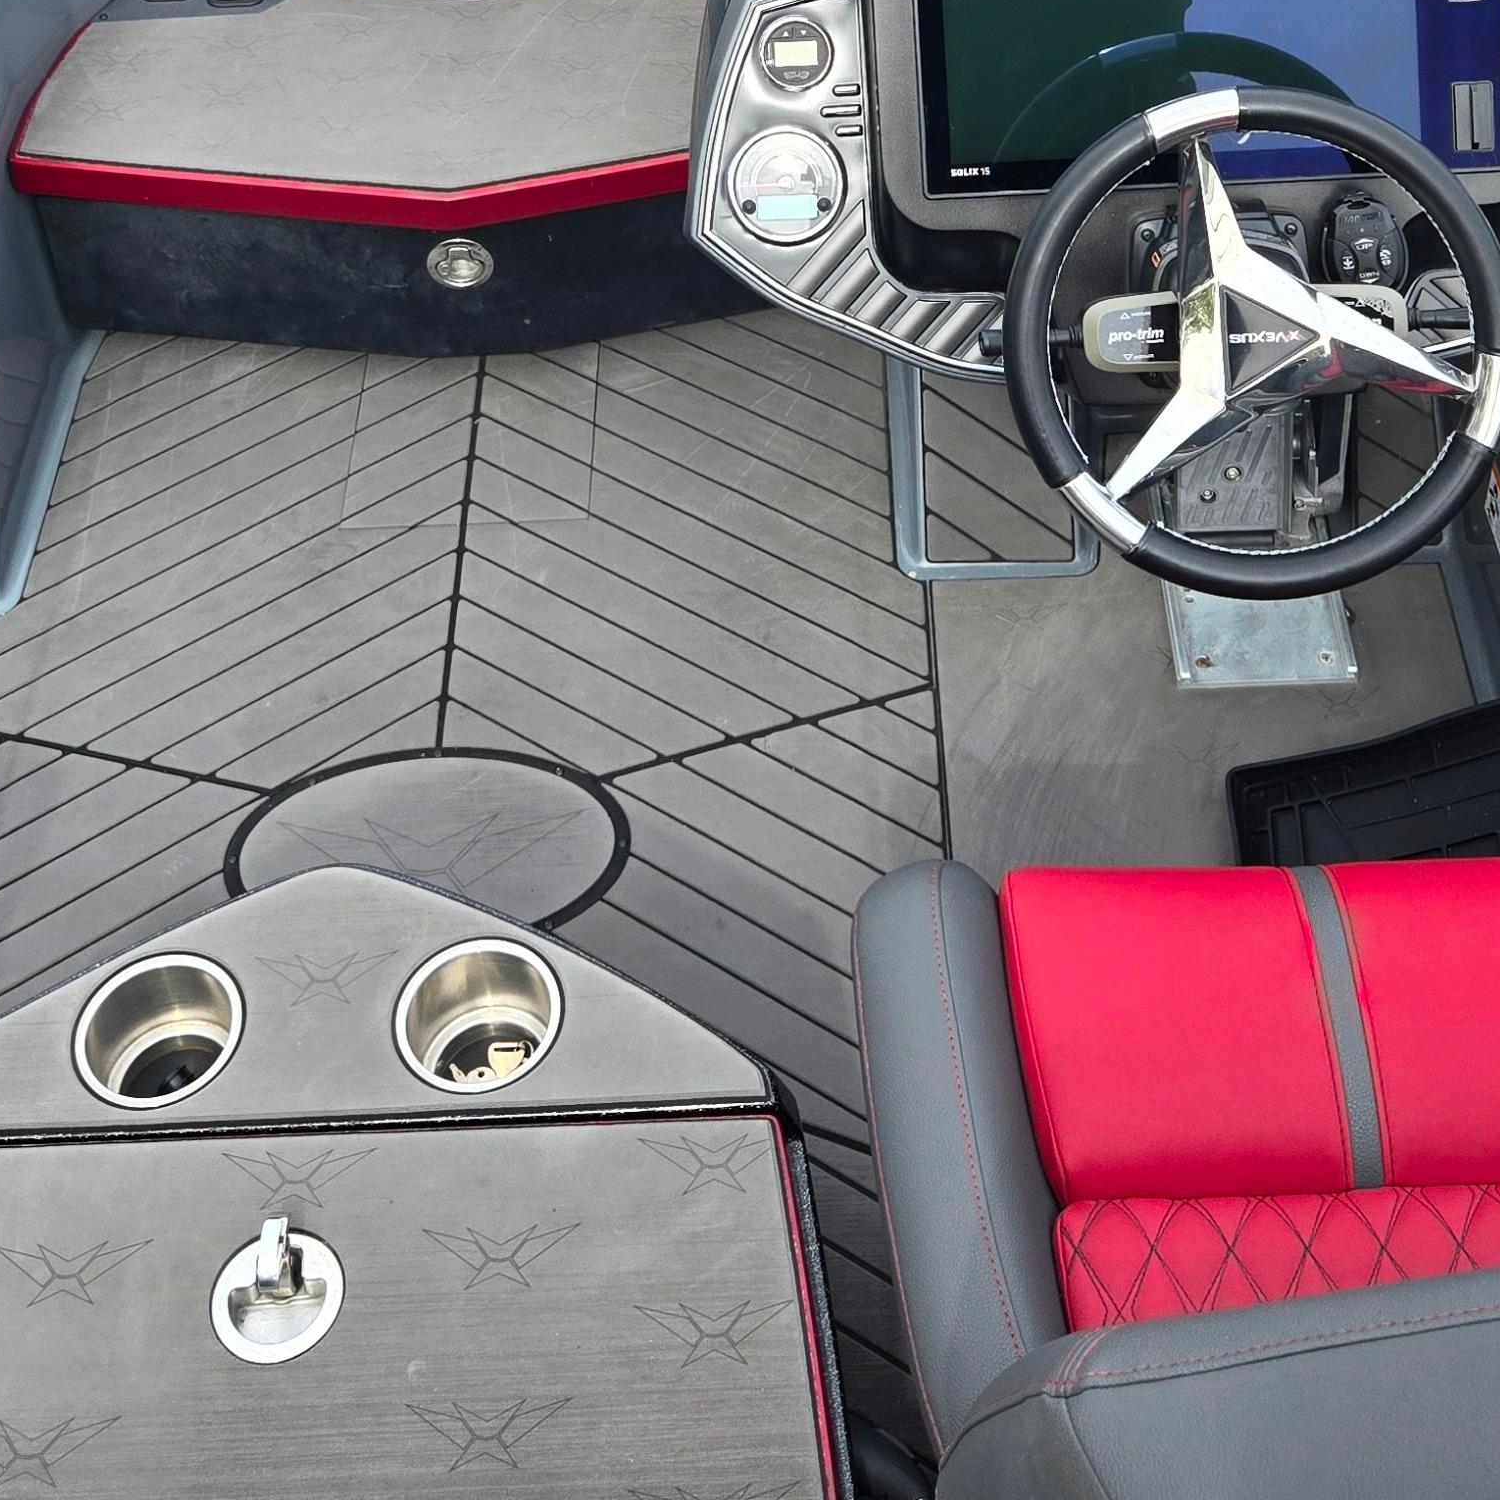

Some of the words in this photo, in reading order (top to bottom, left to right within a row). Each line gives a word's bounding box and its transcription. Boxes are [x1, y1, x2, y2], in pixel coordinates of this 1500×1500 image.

[950, 167, 979, 178] SOLIX
[1107, 327, 1165, 345] pro-trim
[1229, 330, 1287, 344] VEXUS
